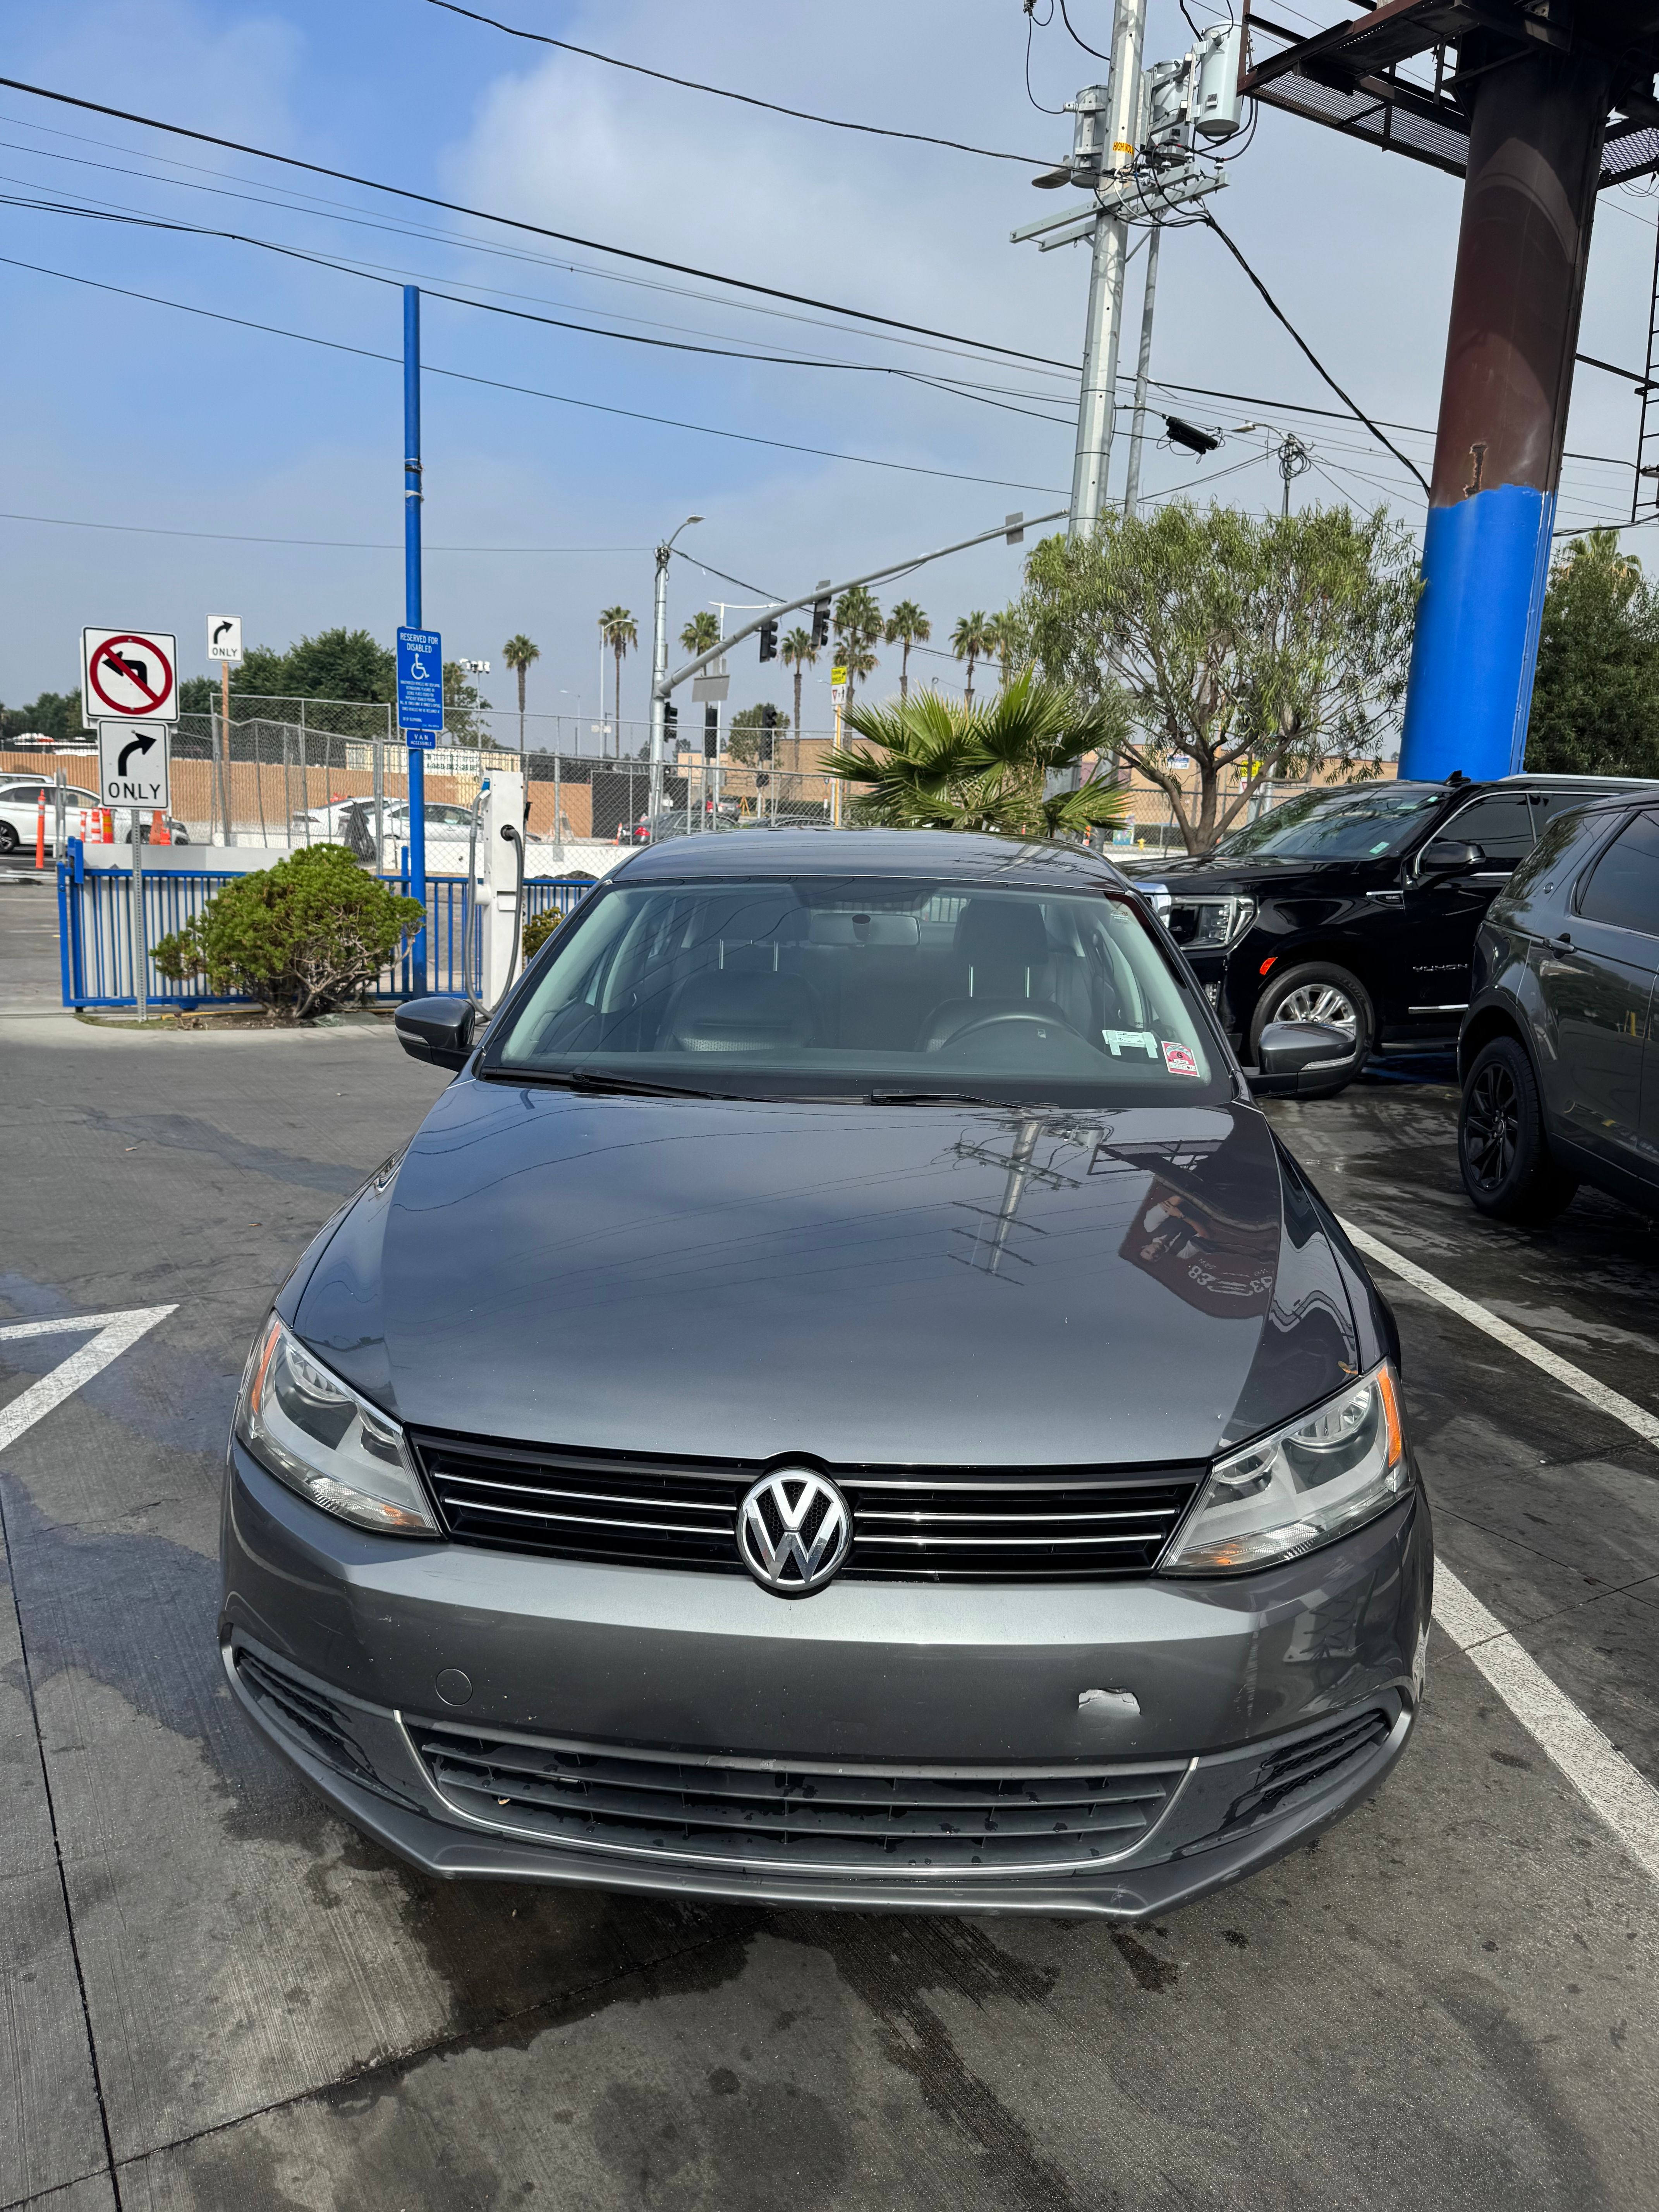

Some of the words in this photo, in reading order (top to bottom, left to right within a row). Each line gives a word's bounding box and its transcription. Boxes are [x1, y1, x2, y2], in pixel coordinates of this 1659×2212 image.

[1113, 142, 1125, 151] HIGH
[400, 632, 426, 644] RESERVED
[428, 636, 438, 645] FOR
[212, 647, 237, 657] ONLY
[407, 643, 432, 653] DISABLED
[108, 782, 161, 800] ONLY
[1413, 963, 1467, 972] YUKON
